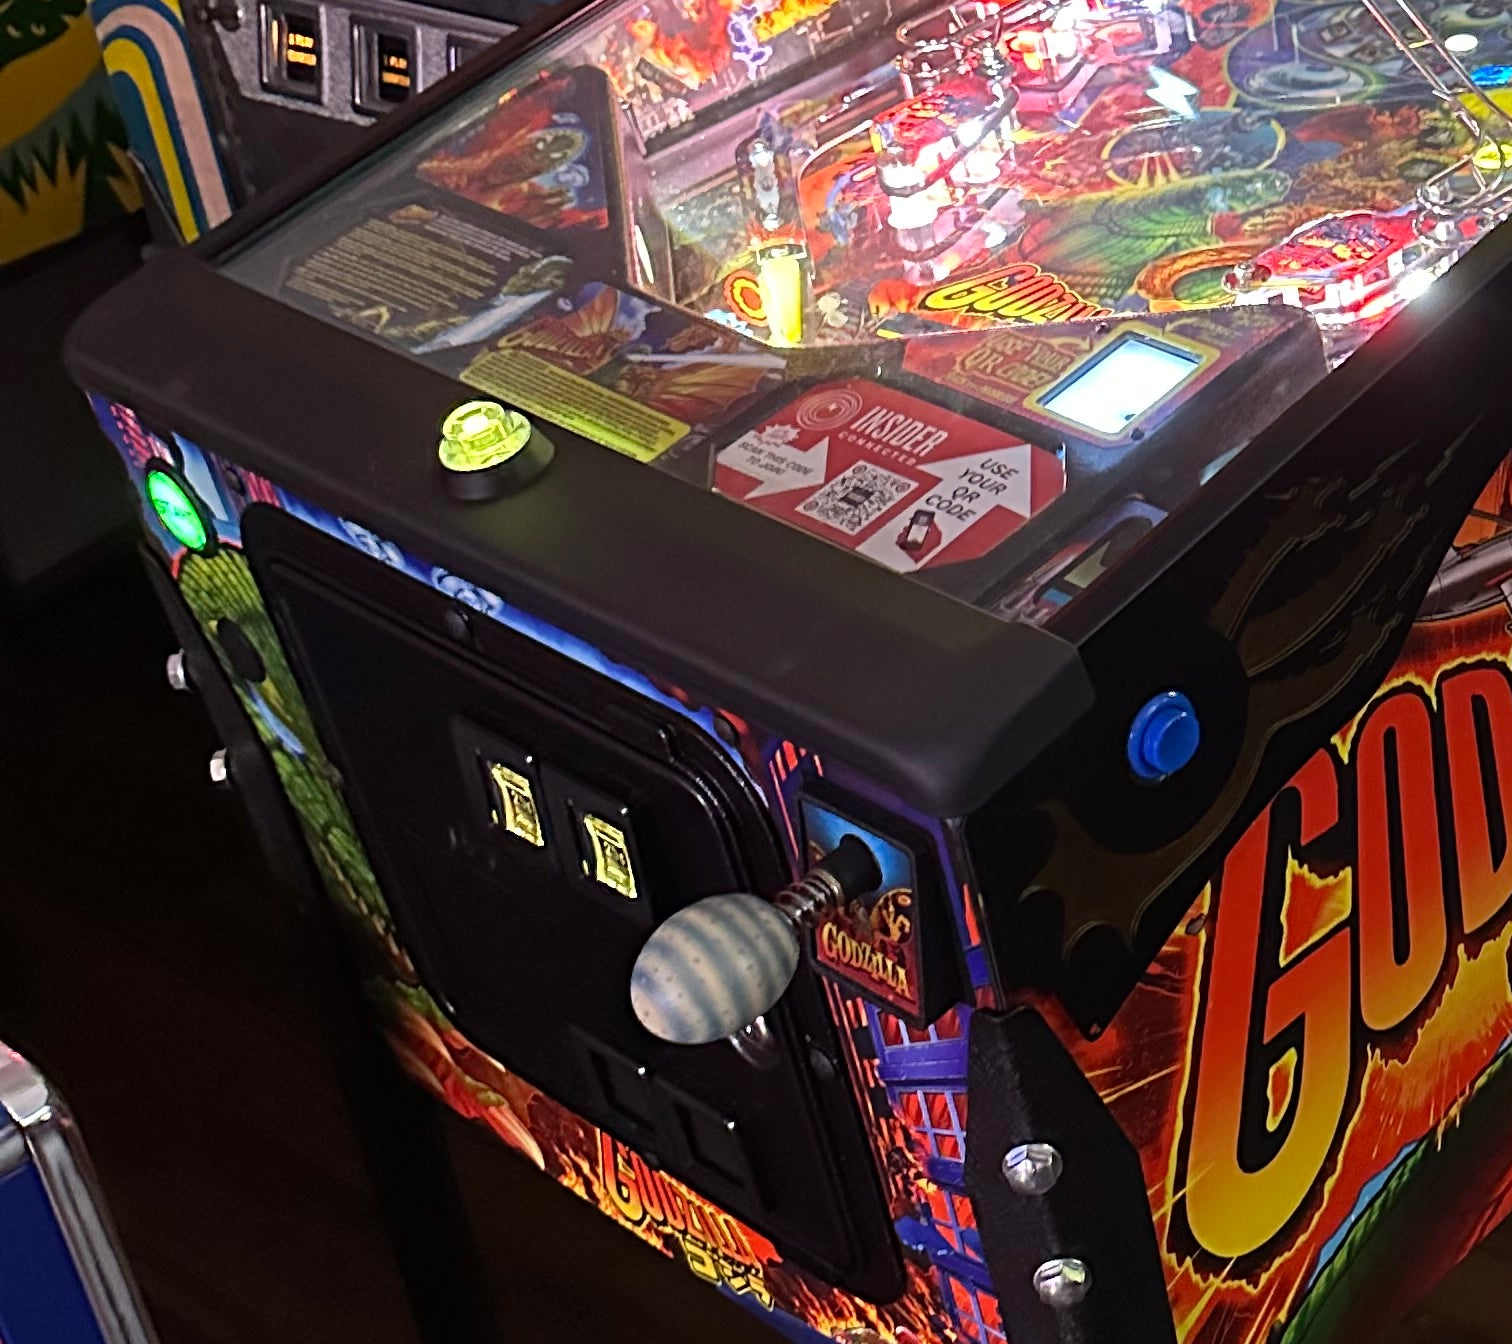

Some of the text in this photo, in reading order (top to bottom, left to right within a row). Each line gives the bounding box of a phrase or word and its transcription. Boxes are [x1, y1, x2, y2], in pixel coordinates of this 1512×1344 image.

[850, 405, 949, 457] INSIDER
[838, 431, 917, 466] CONNECTED
[958, 468, 1007, 495] YOUR
[980, 458, 1019, 480] USE
[925, 494, 977, 522] CODE
[952, 486, 981, 503] QR
[821, 921, 912, 1000] GODZILLA
